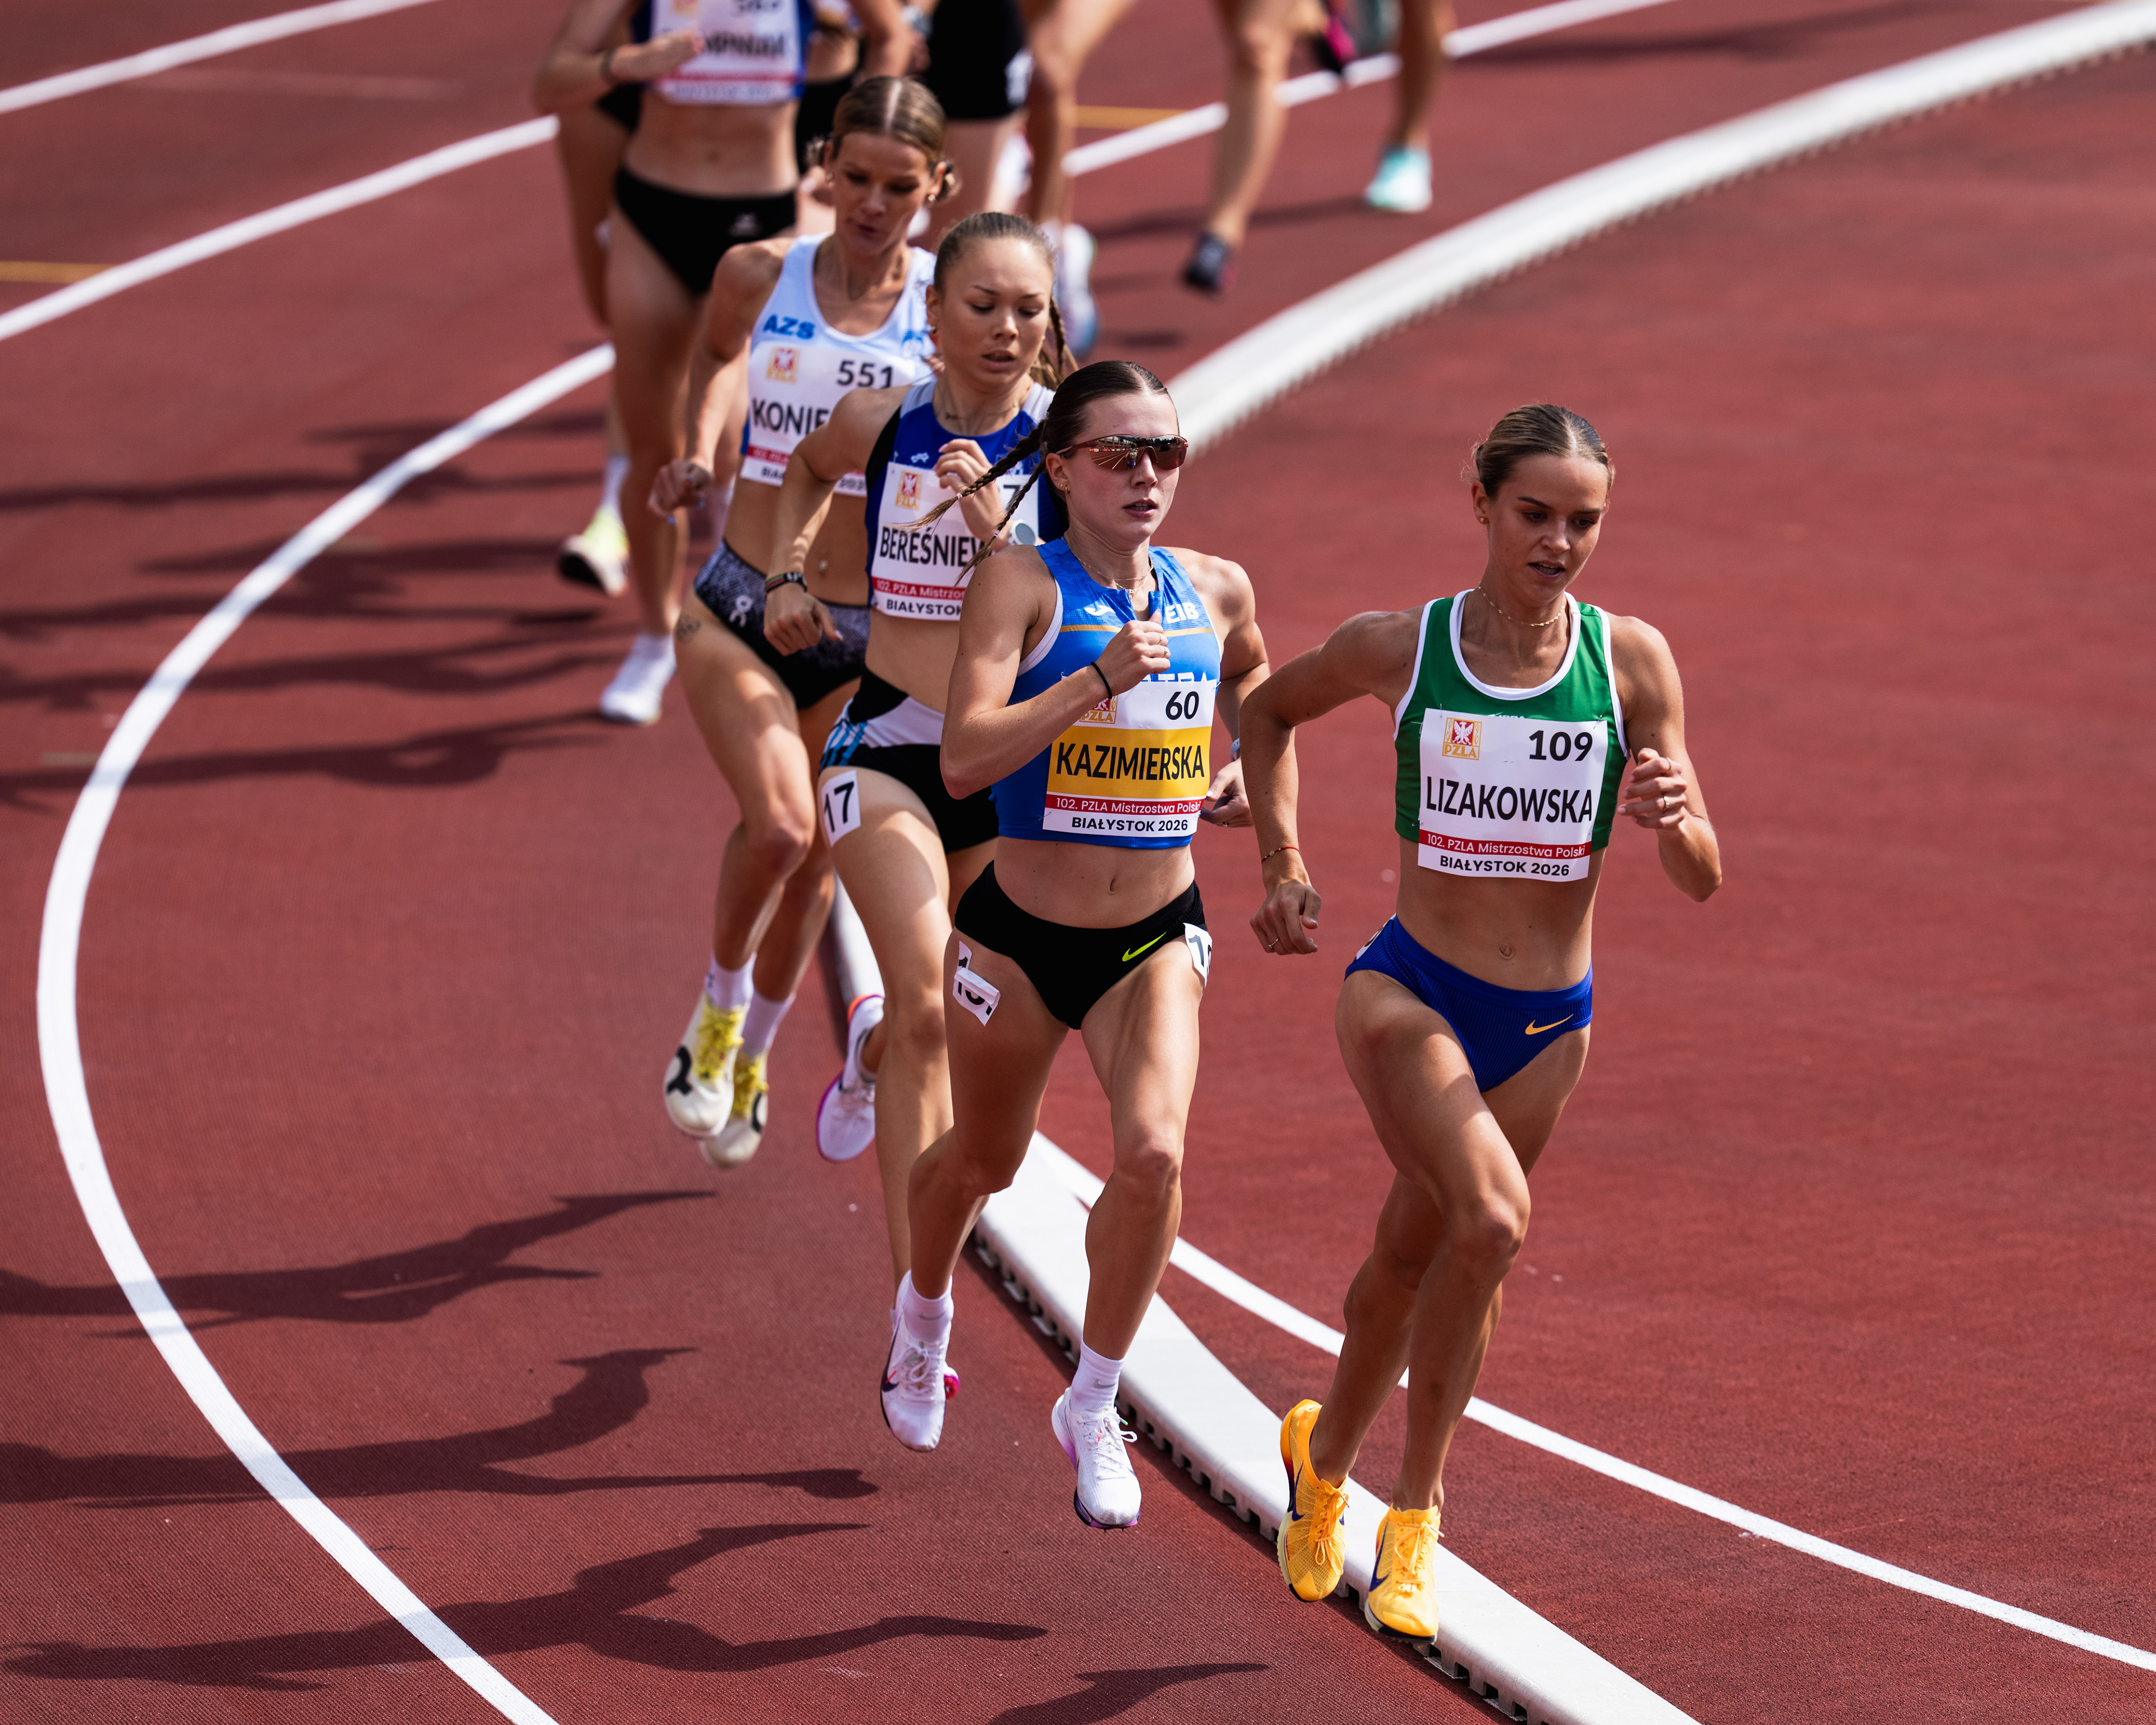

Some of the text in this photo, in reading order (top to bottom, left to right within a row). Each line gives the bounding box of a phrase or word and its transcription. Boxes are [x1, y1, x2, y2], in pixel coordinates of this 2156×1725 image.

[762, 314, 816, 340] AZS
[837, 360, 893, 389] 551
[876, 579, 892, 591] 102.
[893, 583, 918, 596] PZLA
[1081, 711, 1113, 723] PZLA
[1166, 691, 1199, 720] 60
[1444, 743, 1478, 759] PZLA
[1528, 730, 1593, 761] 109
[1056, 742, 1205, 781] KAZIMIERSKA
[824, 781, 855, 834] 17
[1056, 797, 1202, 814] 102. PZLA Mistrzostwa Polski
[1426, 776, 1592, 823] LIZAKOWSKA
[1071, 817, 1189, 832] BIAŁYSTOK 2026
[1427, 833, 1586, 857] 102. PZLA Mistrzostwa Polski
[1440, 855, 1570, 877] BIAŁYSTOK 2026
